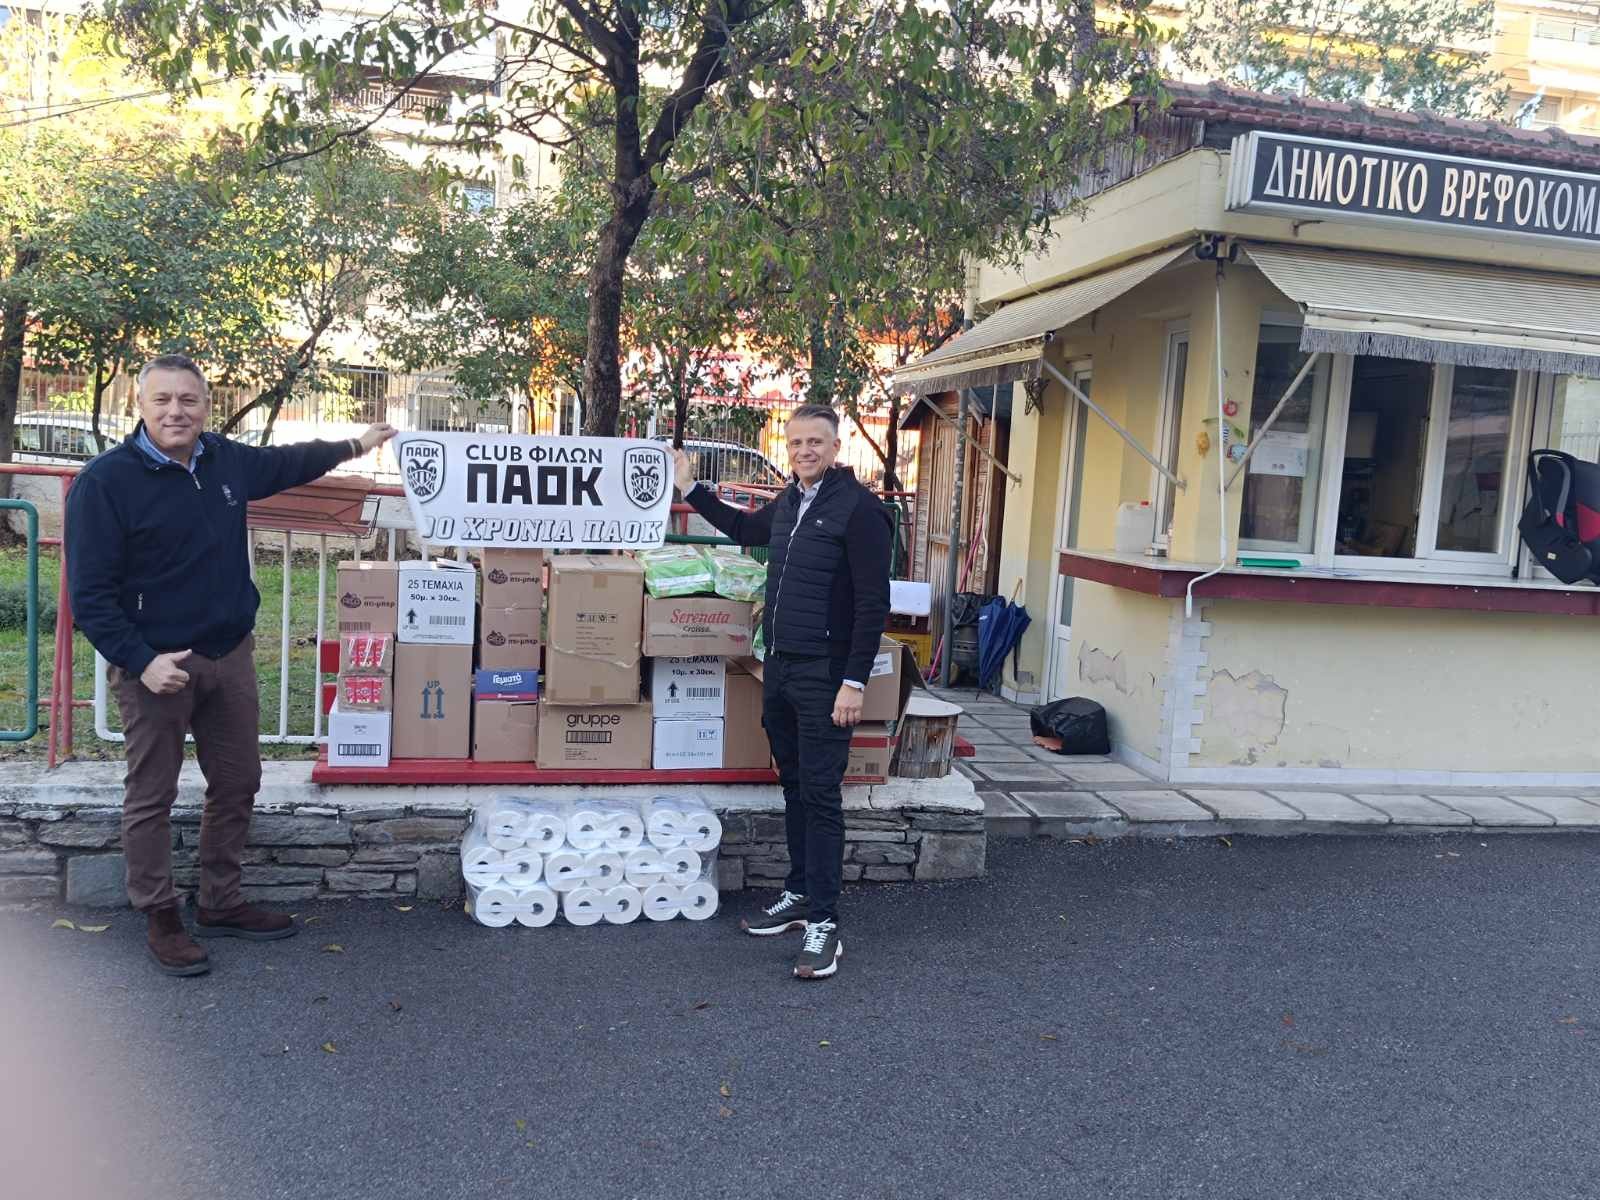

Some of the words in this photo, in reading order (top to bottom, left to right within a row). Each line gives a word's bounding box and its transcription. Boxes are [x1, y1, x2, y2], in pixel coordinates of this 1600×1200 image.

[1262, 145, 1429, 214] ΔΗΜΟΤΙΚΟ
[405, 446, 440, 458] ΠΑΟΚ
[465, 444, 523, 462] CLUB
[528, 445, 603, 464] ΦΙΛΩΝ
[629, 453, 662, 465] ΠΑΟΚ
[466, 463, 604, 507] ΠΑΟΚ
[460, 517, 574, 542] ΧΡΟΝΙΑ
[581, 519, 664, 544] ΠΑΟΚ
[407, 579, 420, 589] 25
[421, 579, 464, 591] ΤΕΜΑΧΙΑ
[670, 608, 731, 624] Serenata
[426, 680, 441, 689] UP
[566, 713, 621, 728] gruppe
